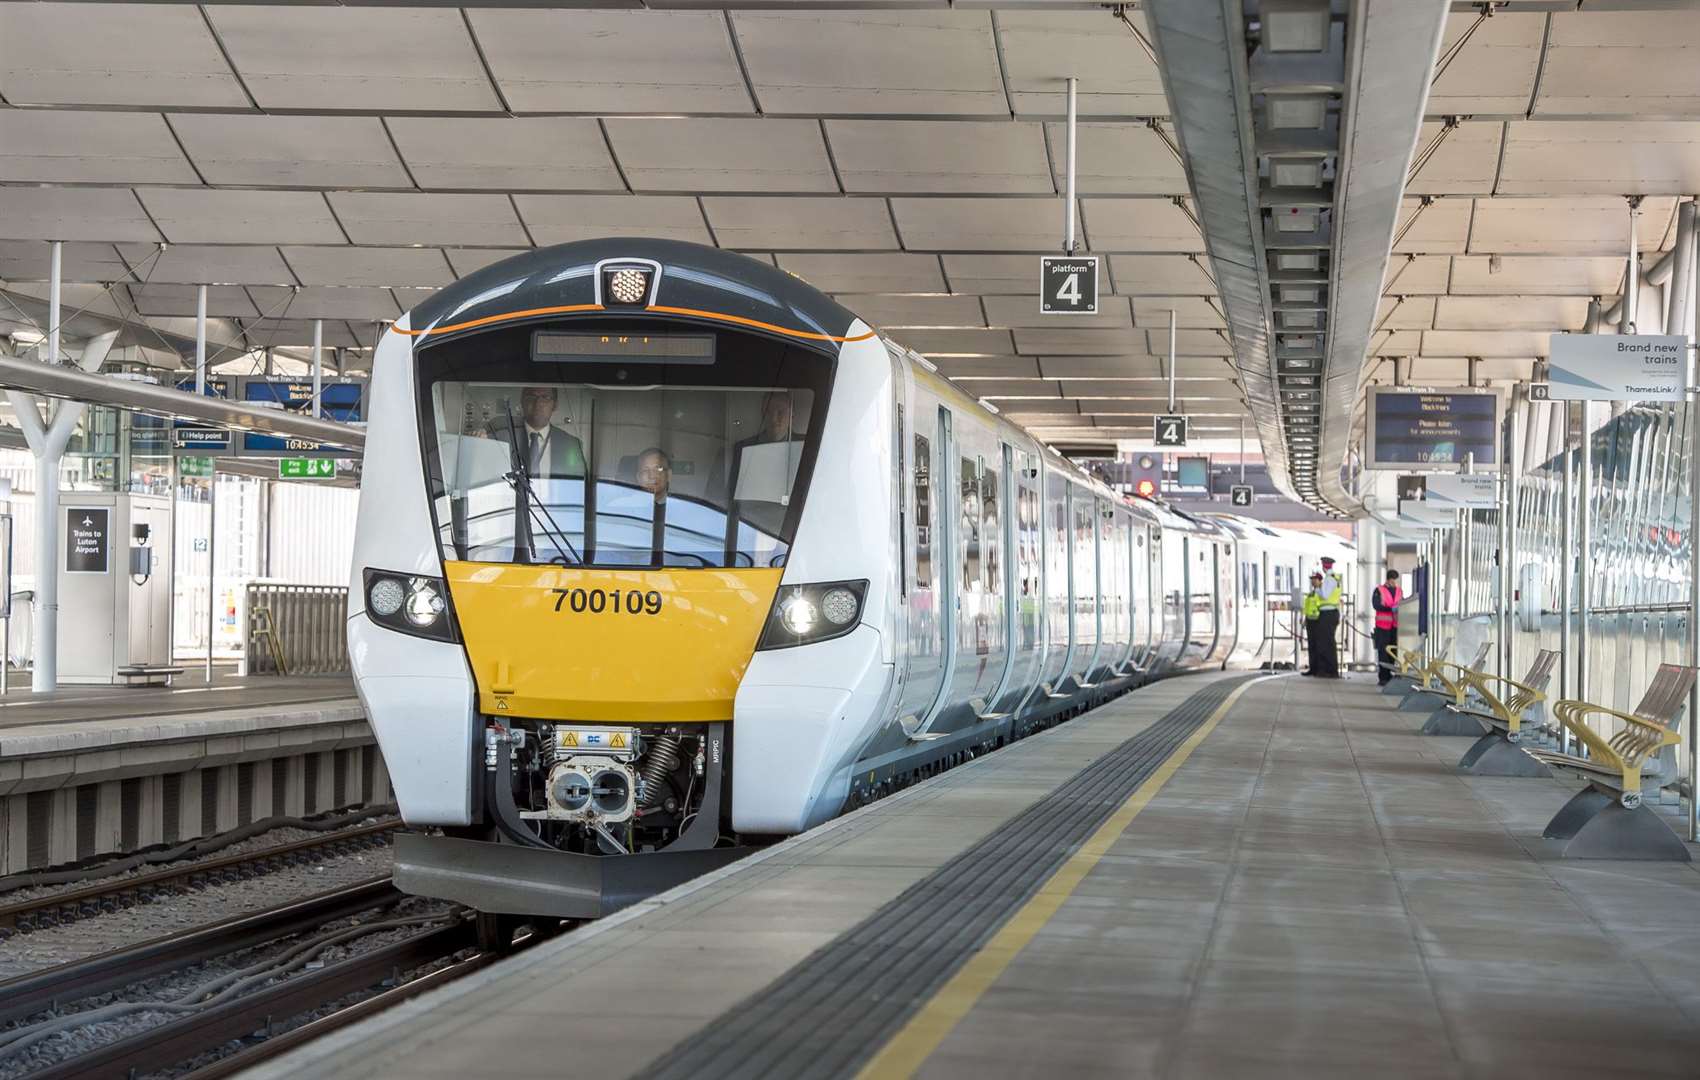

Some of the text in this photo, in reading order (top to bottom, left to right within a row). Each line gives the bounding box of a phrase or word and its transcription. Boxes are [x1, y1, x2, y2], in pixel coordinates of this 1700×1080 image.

[1052, 264, 1088, 274] platform
[1056, 273, 1082, 305] 4
[1617, 342, 1678, 353] Brand new
[1645, 354, 1677, 364] trains
[188, 432, 222, 440] Help point
[1162, 424, 1179, 442] 4
[1236, 491, 1247, 505] 4
[73, 530, 93, 538] Trains
[75, 546, 99, 554] Airport
[552, 588, 663, 615] 700109
[587, 735, 601, 743] DC
